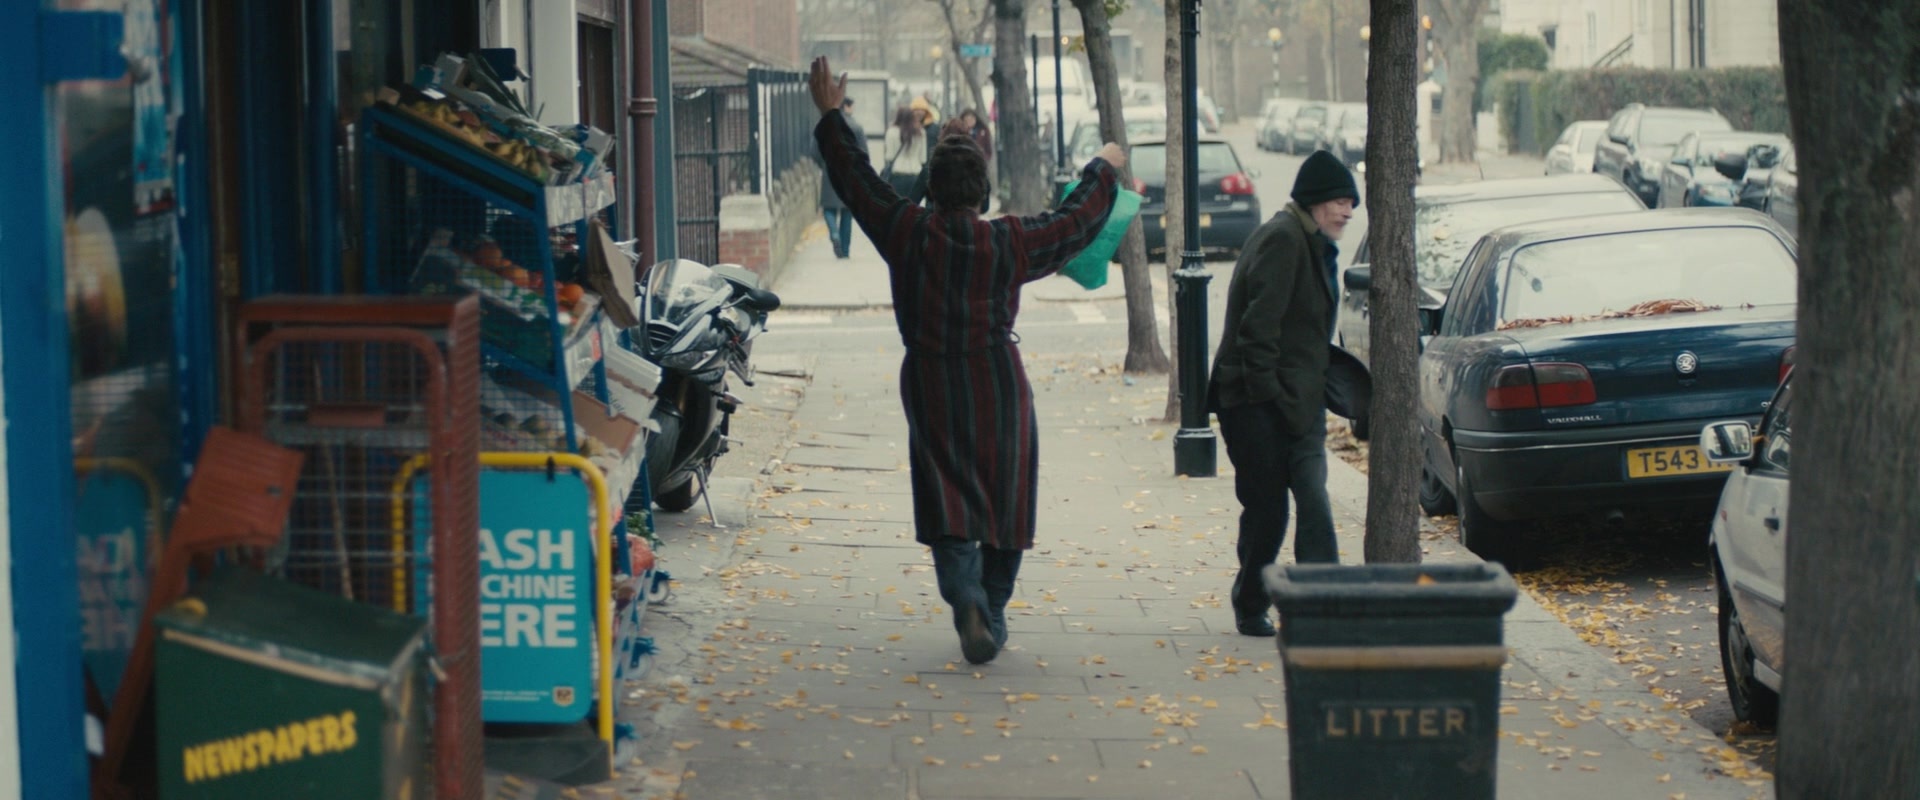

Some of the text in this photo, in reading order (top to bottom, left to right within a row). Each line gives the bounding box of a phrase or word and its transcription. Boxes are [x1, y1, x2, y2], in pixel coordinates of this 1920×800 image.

[1547, 415, 1602, 424] VAUXHALL
[1638, 450, 1699, 473] T543
[427, 529, 574, 570] ASH
[427, 574, 576, 599] CHINE
[427, 603, 577, 648] ERE
[1326, 708, 1465, 737] LITTER
[184, 710, 357, 783] NEWSPAPERS
